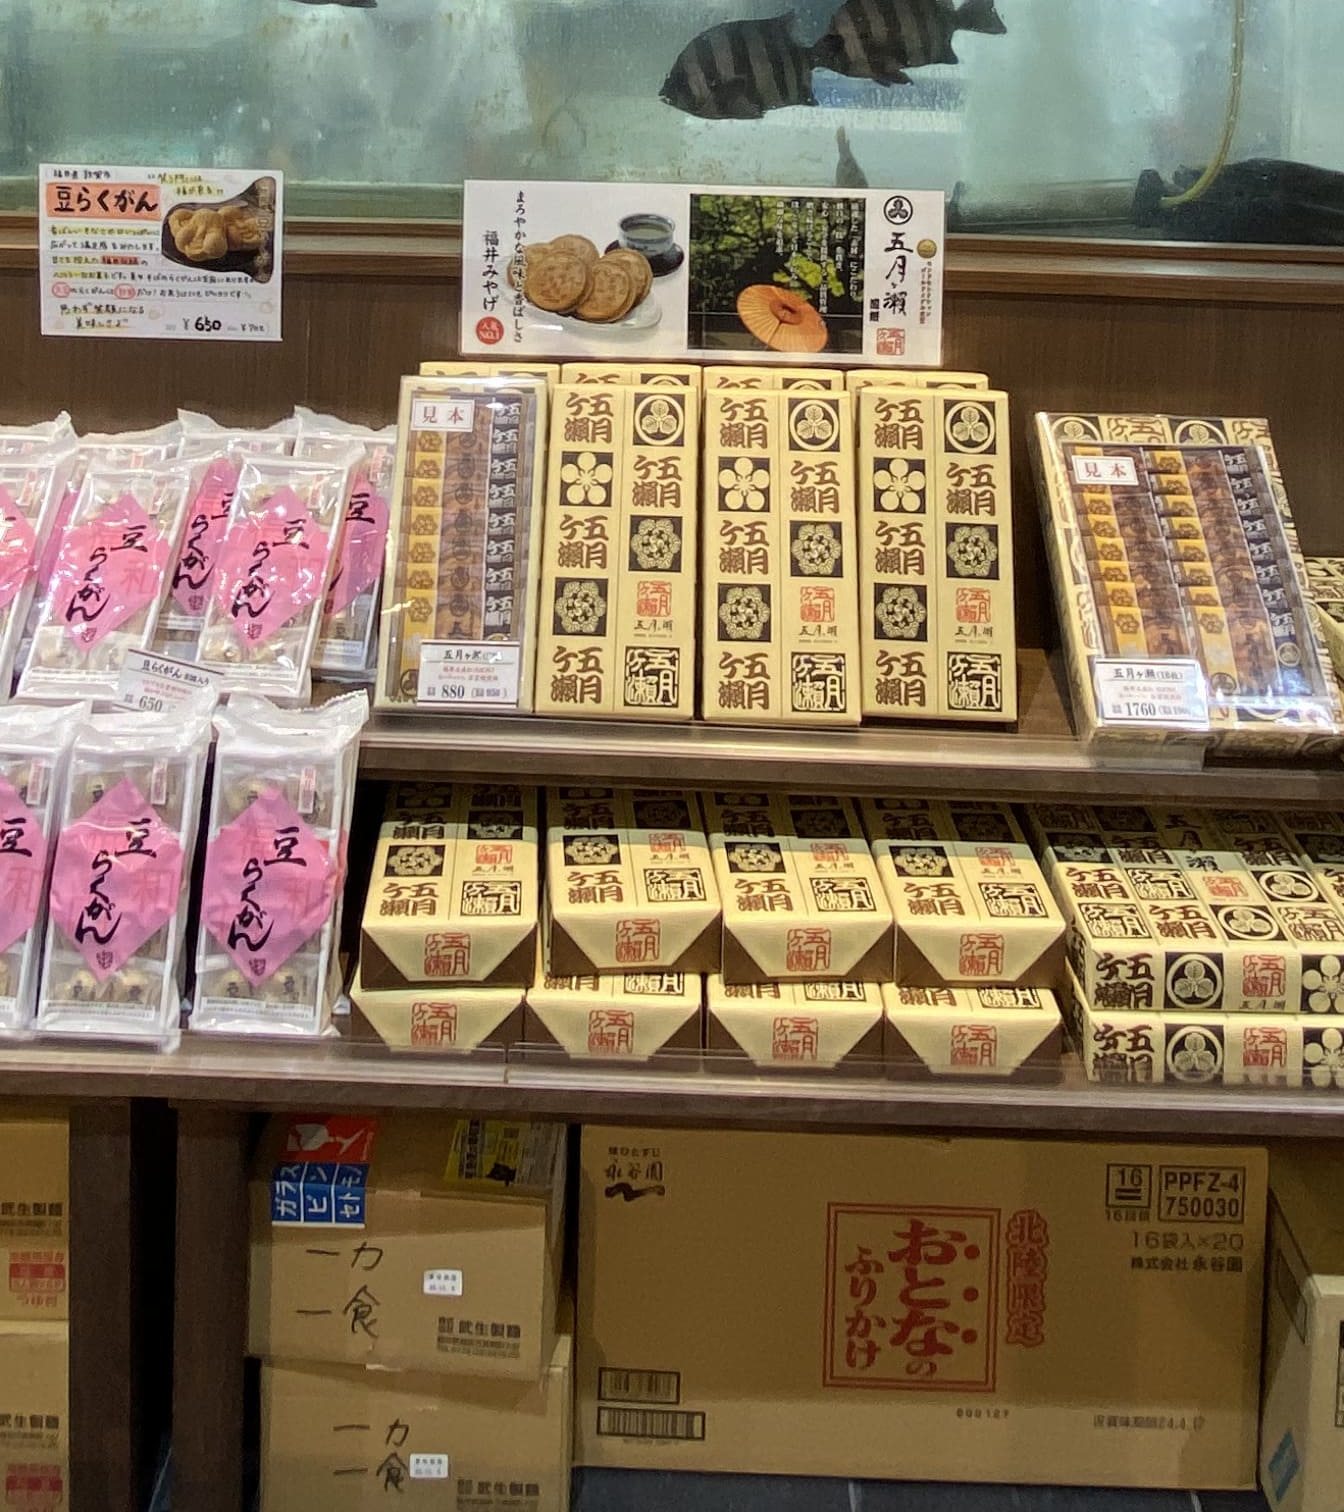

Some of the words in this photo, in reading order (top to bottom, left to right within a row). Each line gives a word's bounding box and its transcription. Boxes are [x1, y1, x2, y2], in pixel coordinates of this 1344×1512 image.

[54, 185, 159, 213] 豆らくがん
[482, 230, 500, 312] 福井みやげ
[423, 405, 465, 424] 見本
[1084, 462, 1128, 479] 見本
[441, 684, 465, 699] 880
[138, 695, 163, 714] 650
[1124, 702, 1157, 717] 1760
[76, 818, 158, 947] 豆らくがん
[228, 825, 307, 953] 豆らくがん
[1117, 1167, 1144, 1188] 16
[1163, 1170, 1240, 1193] PPFZ-4
[1165, 1195, 1240, 1218] 750030
[844, 1246, 886, 1369] ふりかけ
[889, 1218, 962, 1379] おとなの
[296, 1283, 381, 1339] 一食
